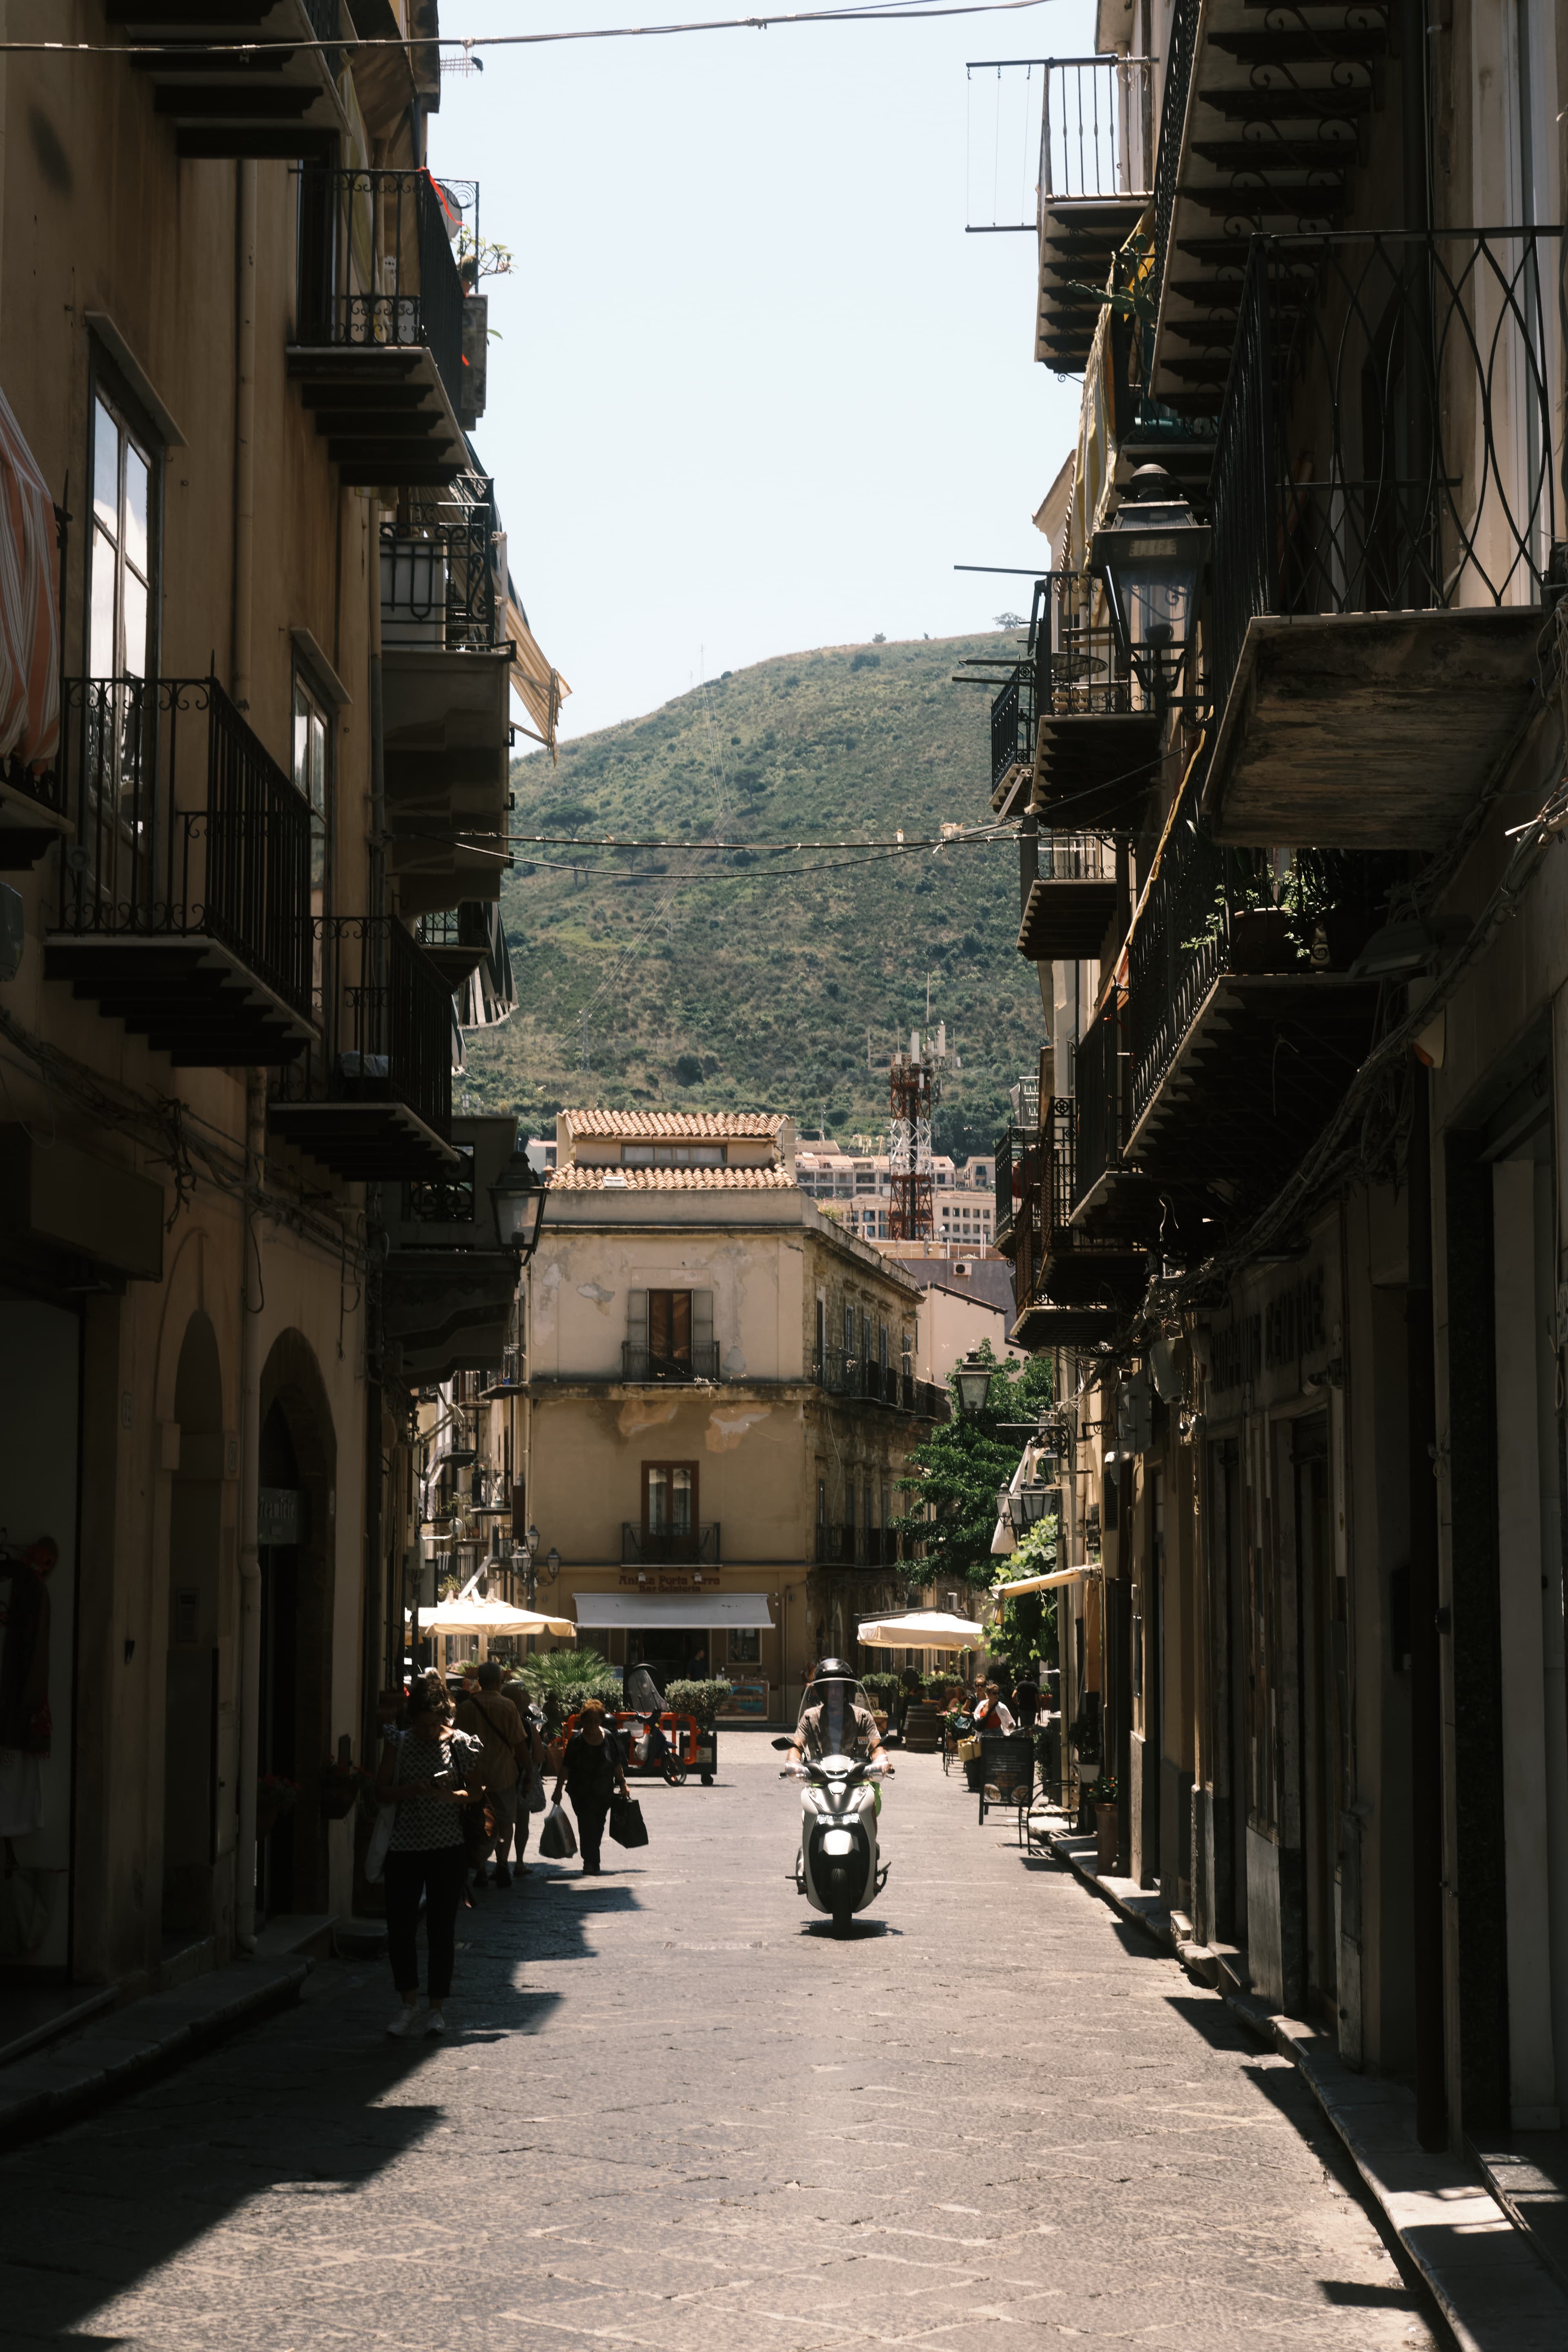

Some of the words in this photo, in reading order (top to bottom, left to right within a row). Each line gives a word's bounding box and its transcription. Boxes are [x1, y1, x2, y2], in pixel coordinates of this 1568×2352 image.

[1209, 1313, 1261, 1392] SHOPPING
[1266, 1267, 1326, 1371] CENTRE
[659, 1575, 687, 1585] Porta
